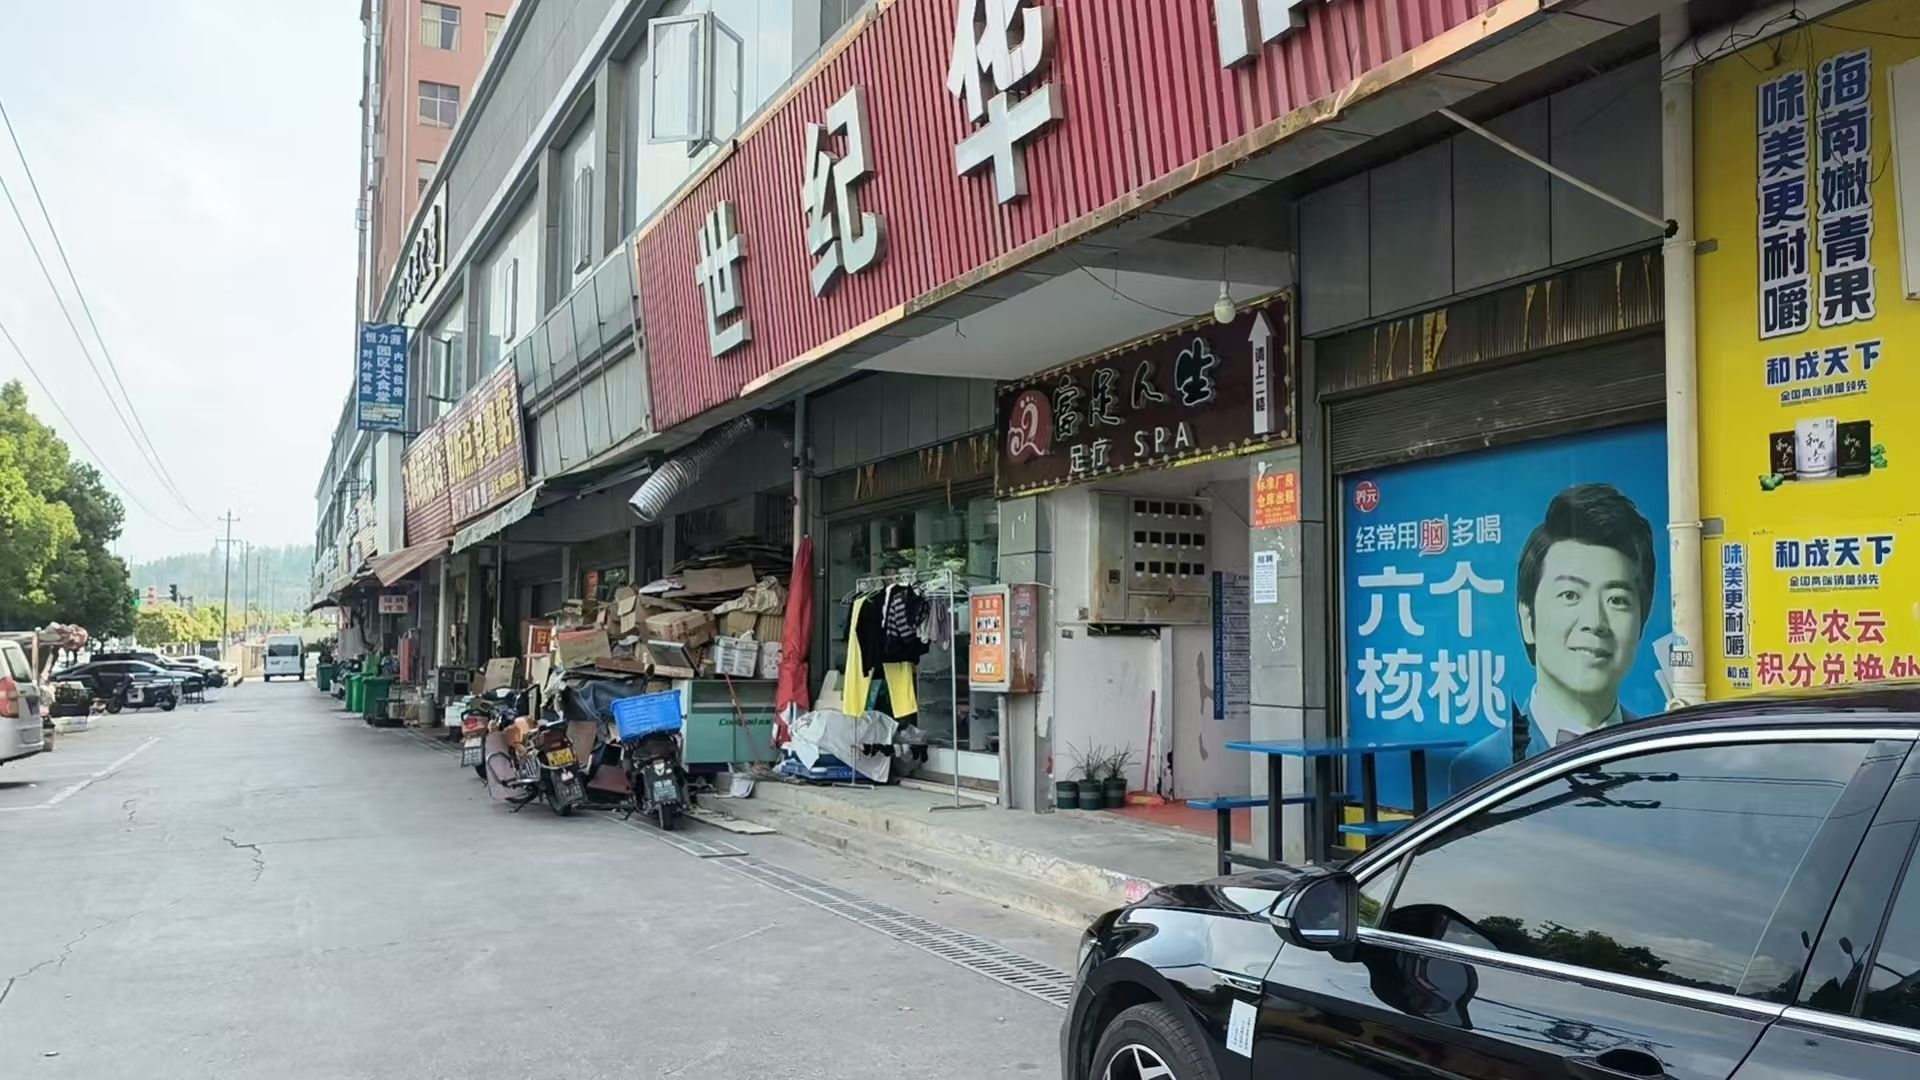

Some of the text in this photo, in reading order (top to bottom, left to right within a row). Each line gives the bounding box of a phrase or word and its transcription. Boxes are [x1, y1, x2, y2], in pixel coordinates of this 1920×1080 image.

[695, 0, 1308, 358] 世纪华
[1820, 52, 1871, 321] 海南嫩青果
[1762, 74, 1808, 333] 味美更耐嚼
[361, 349, 373, 394] 对外营业
[376, 345, 391, 402] 园区大食堂
[393, 352, 404, 397] 内设包房
[1256, 346, 1265, 412] 请上二楼
[1767, 340, 1881, 386] 和成天下
[1781, 380, 1868, 402] 全国高端销量领先
[1070, 421, 1190, 474] 足疗 SPA
[1257, 490, 1295, 508] 仓库出租
[1355, 489, 1377, 504] 养元
[1355, 514, 1501, 557] 经常用脑多喝
[1775, 535, 1894, 569] 和成天下
[1358, 561, 1505, 638] 六个
[1723, 544, 1745, 657] 味美更耐嚼
[1790, 573, 1879, 587] 全国高端销量领先
[1788, 610, 1886, 644] 黔农云
[1356, 647, 1507, 728] 核桃
